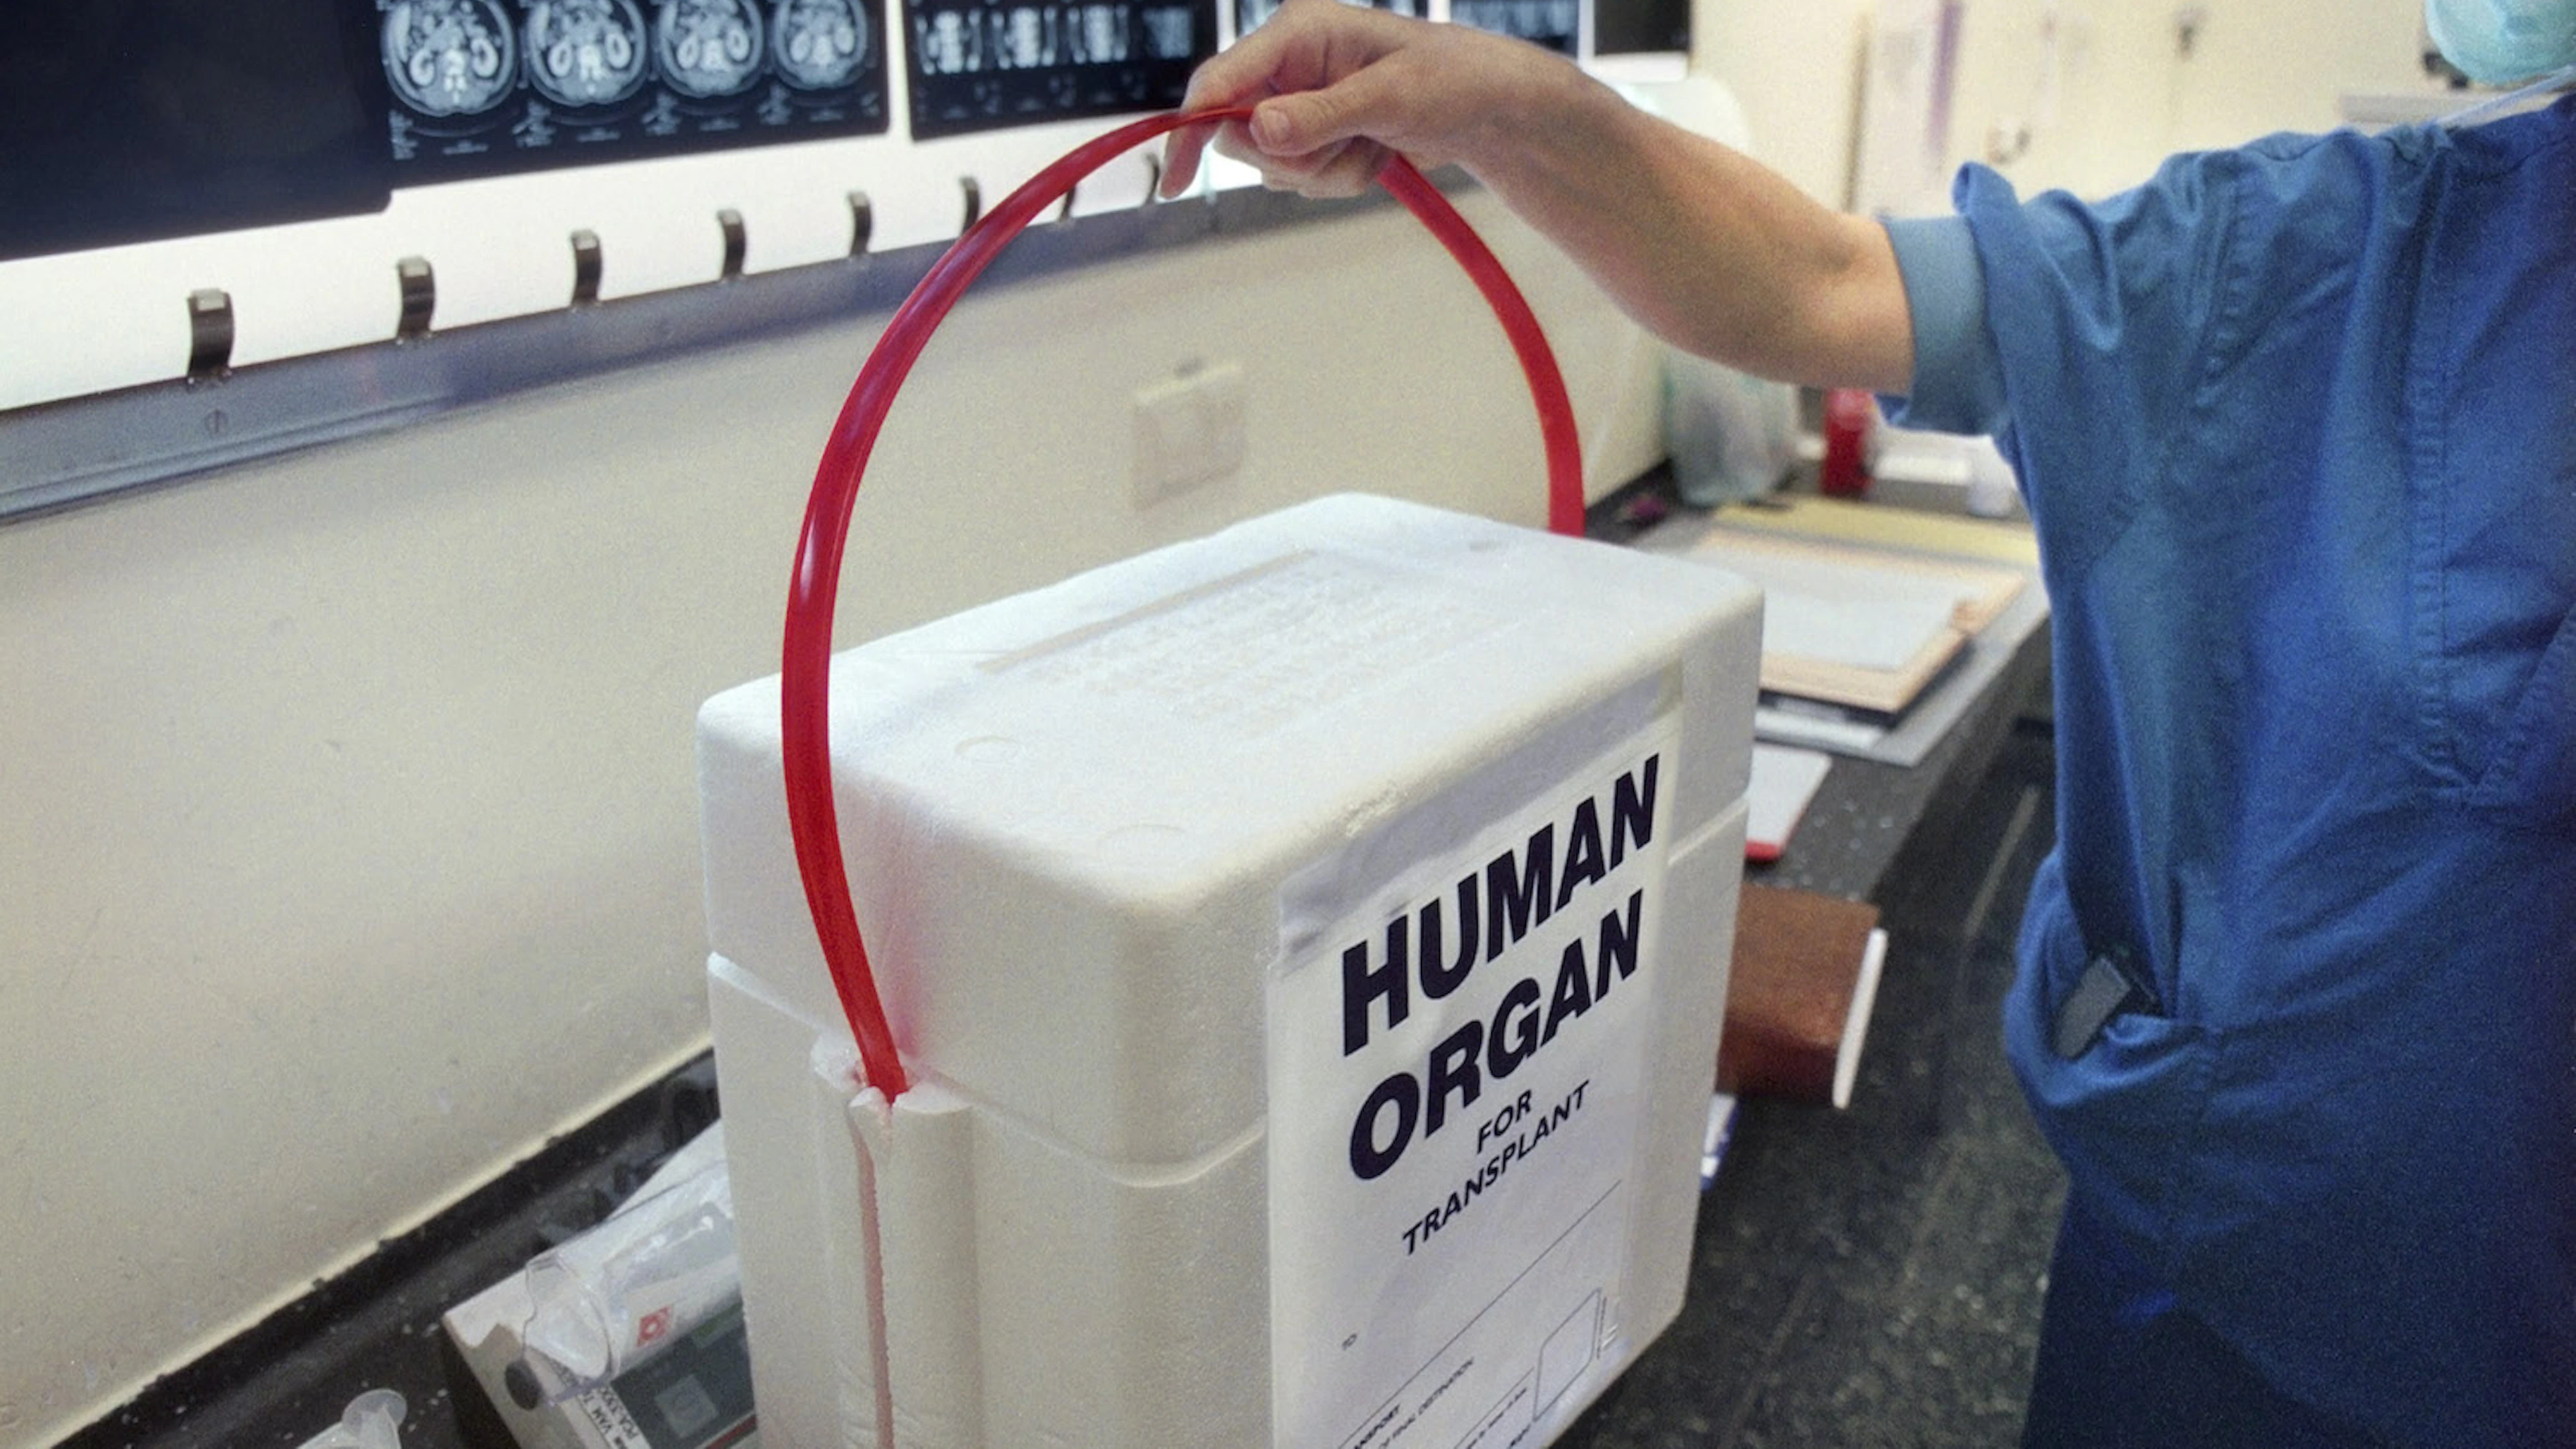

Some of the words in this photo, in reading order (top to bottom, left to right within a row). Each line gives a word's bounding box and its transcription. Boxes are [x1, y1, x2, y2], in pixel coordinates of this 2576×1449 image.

[1342, 753, 1660, 1057] HUMAN
[1349, 888, 1643, 1181] ORGAN
[1476, 1089, 1532, 1155] FOR
[1401, 1079, 1589, 1255] TRANSPLANT
